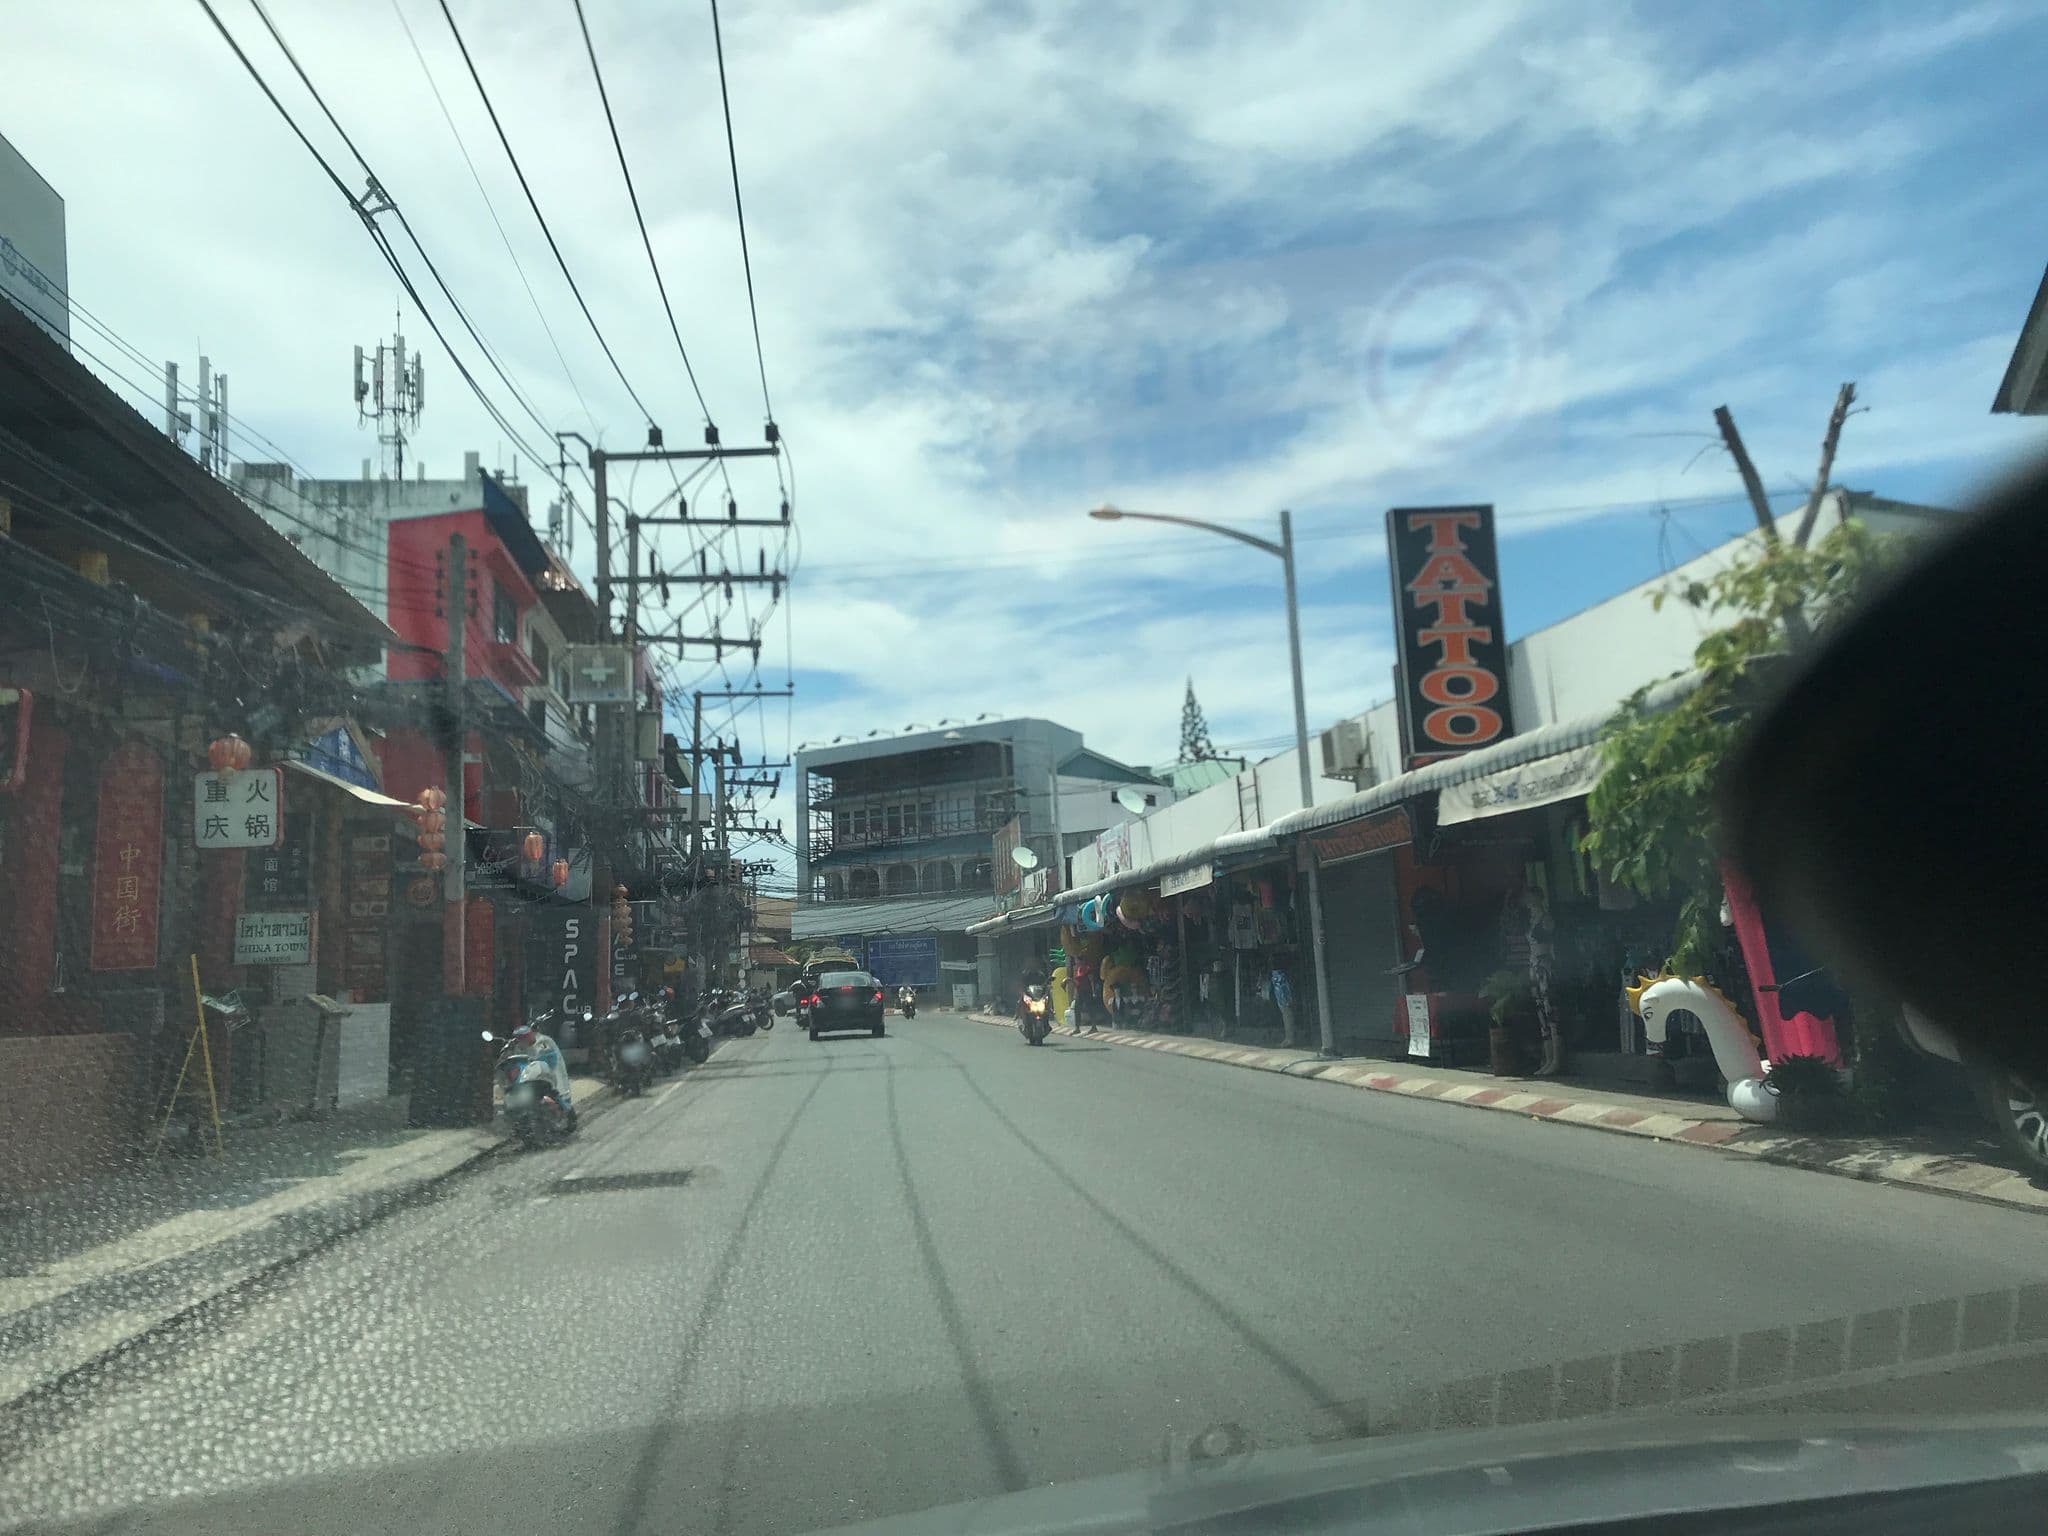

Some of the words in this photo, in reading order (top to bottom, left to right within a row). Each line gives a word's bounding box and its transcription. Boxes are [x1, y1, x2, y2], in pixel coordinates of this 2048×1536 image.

[1405, 511, 1503, 745] TATTOO
[244, 779, 270, 839] 火锅
[112, 842, 142, 933] 中国街
[239, 944, 271, 953] CHINA
[275, 943, 307, 952] TOWN
